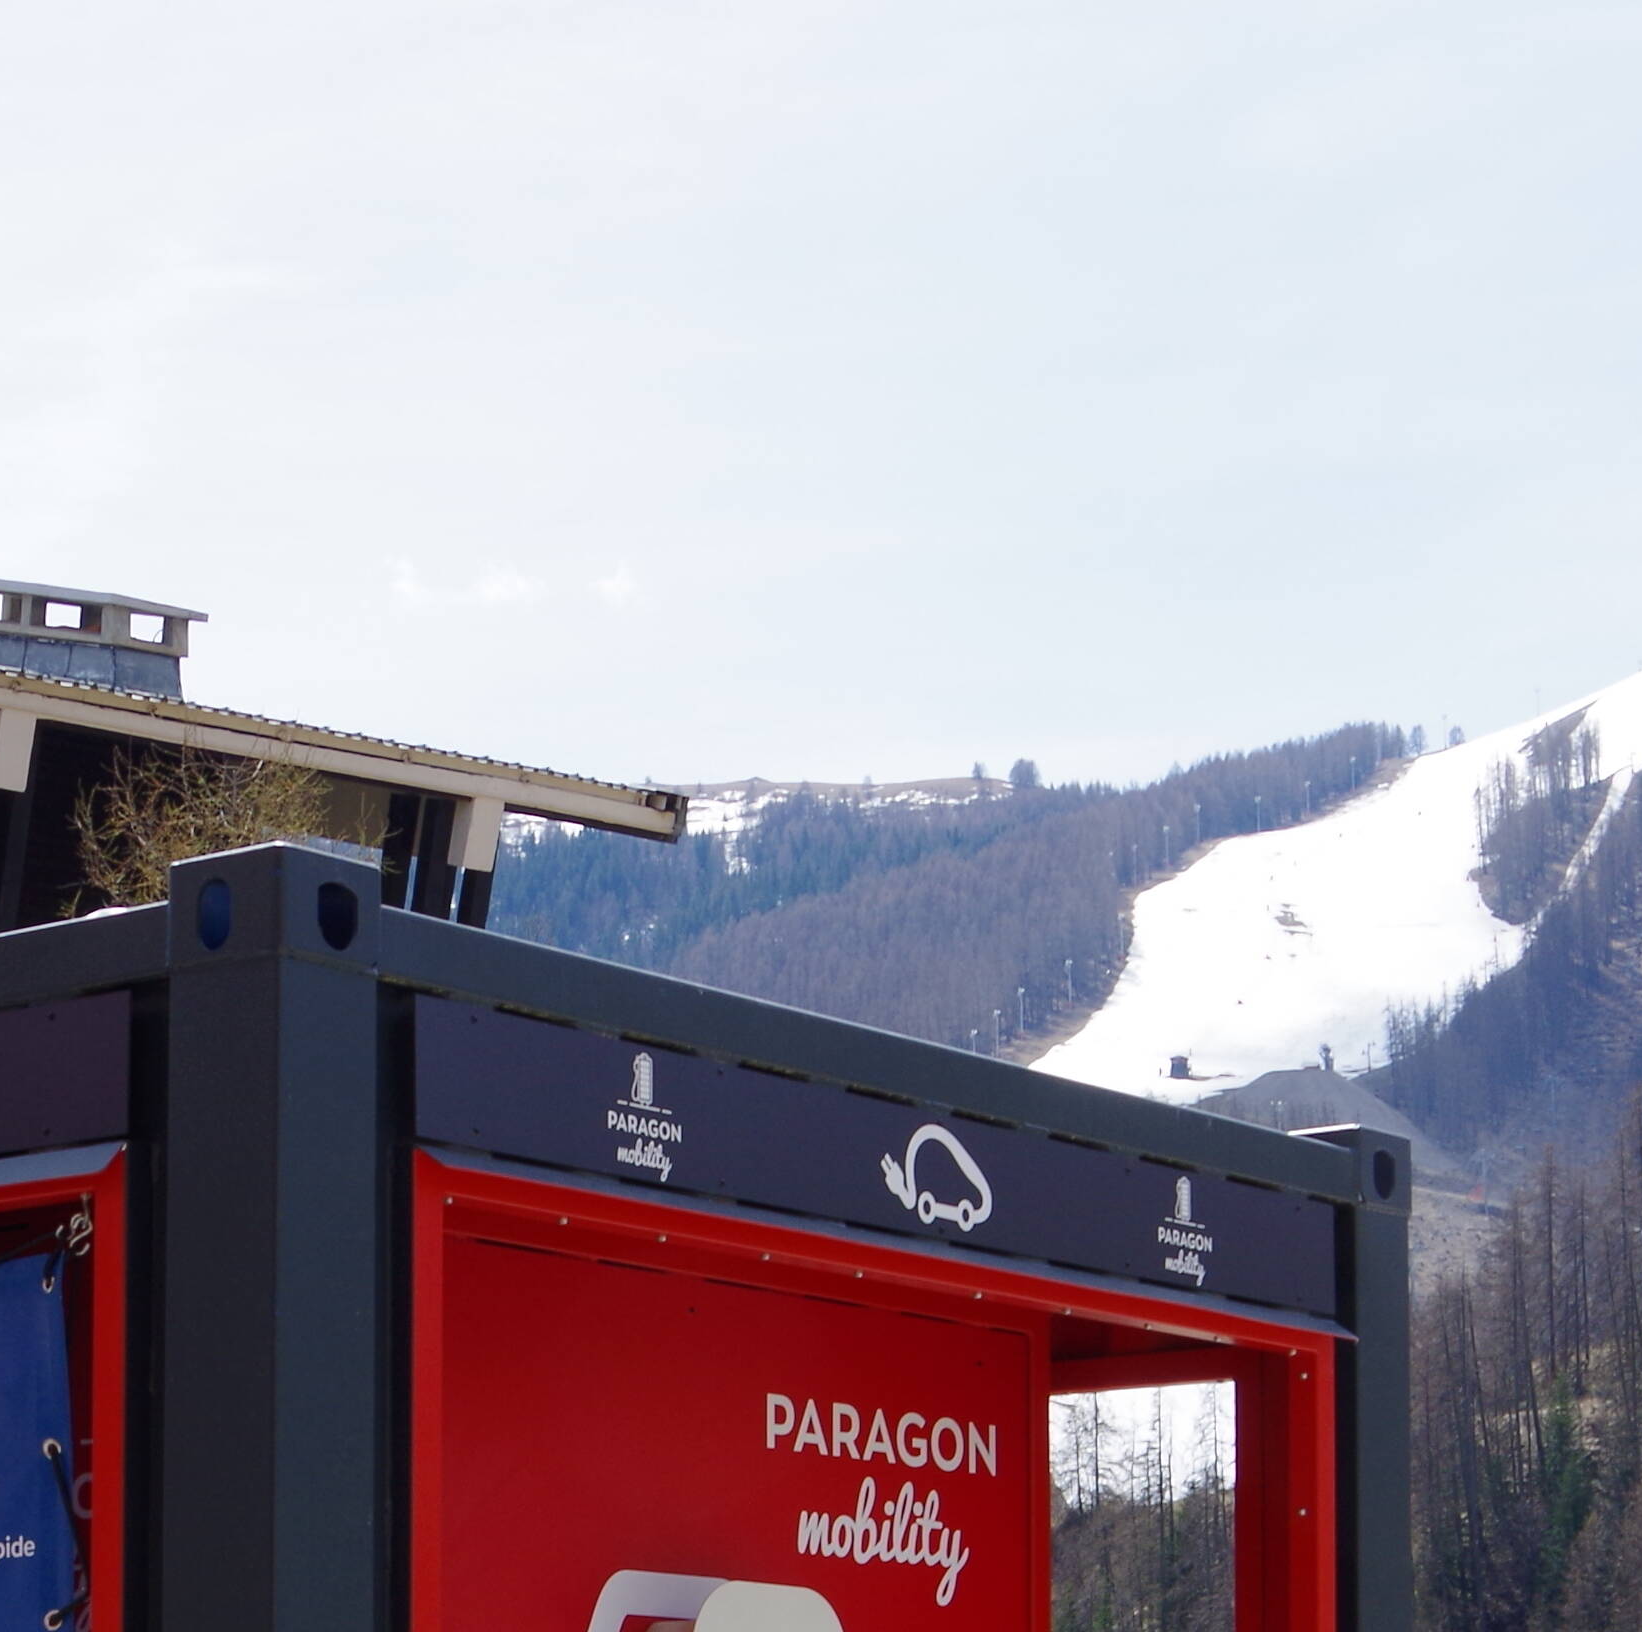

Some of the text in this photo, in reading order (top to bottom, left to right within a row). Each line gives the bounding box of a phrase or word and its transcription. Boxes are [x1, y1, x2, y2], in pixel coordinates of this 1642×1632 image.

[608, 1109, 682, 1143] PARAGON
[617, 1138, 672, 1182] mobility
[1158, 1224, 1212, 1252] PARAGON
[1165, 1249, 1205, 1286] mobility
[767, 1393, 996, 1477] PARAGON
[796, 1476, 970, 1607] mobility
